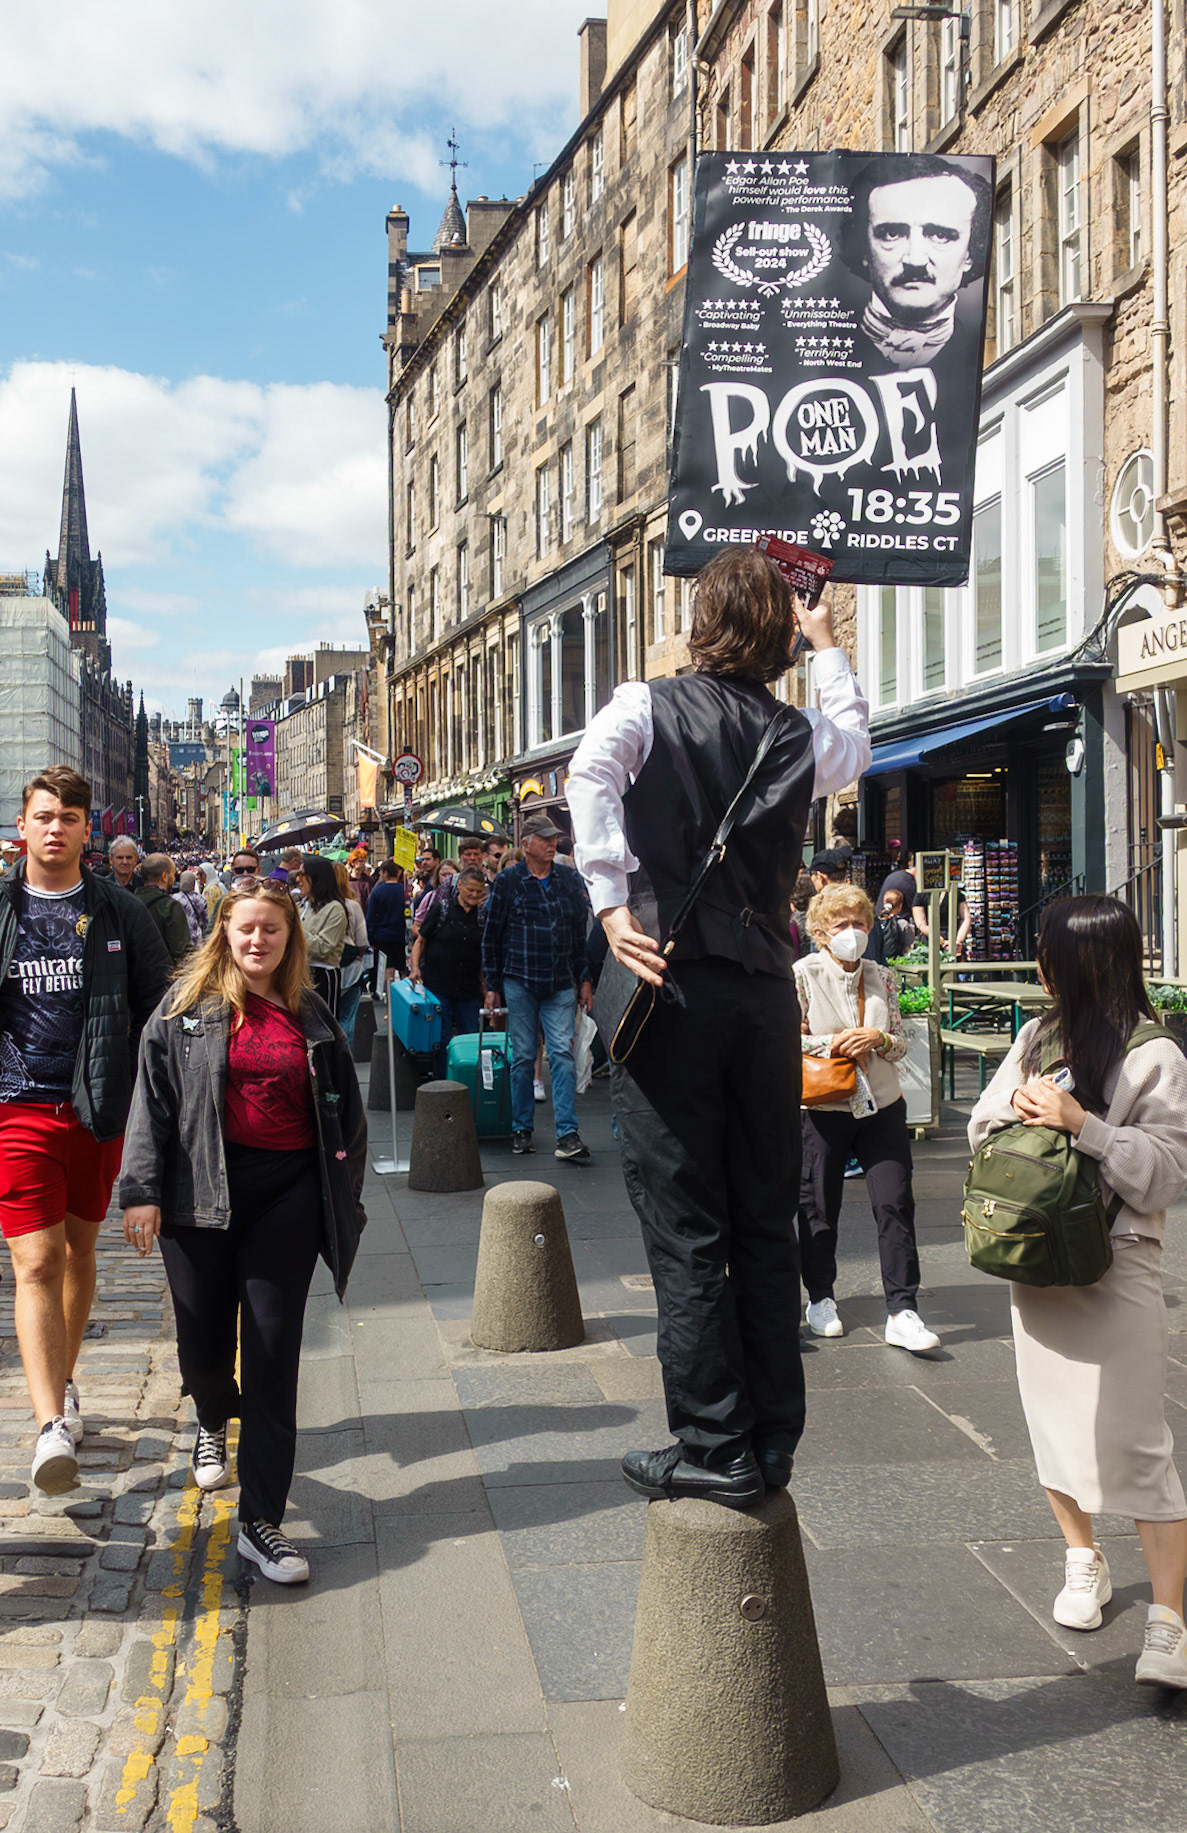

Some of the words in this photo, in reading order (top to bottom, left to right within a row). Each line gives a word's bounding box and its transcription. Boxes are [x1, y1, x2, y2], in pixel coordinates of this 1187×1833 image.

[759, 176, 786, 185] Allan
[788, 176, 809, 185] Poe
[729, 185, 767, 195] himself
[769, 186, 802, 195] would
[803, 186, 827, 195] love
[828, 185, 848, 195] this
[732, 196, 780, 205] powerful
[748, 220, 801, 243] fringe
[735, 246, 778, 257] Sell-out
[779, 246, 809, 257] show
[754, 257, 787, 269] 2024
[703, 321, 740, 331] Broadway
[740, 322, 760, 331] Baby
[787, 320, 828, 329] Everything
[828, 320, 858, 329] Theatre
[712, 364, 773, 373] MyTheatreMates
[847, 360, 863, 368] End
[797, 397, 850, 429] ONE
[699, 367, 942, 508] POE
[800, 426, 856, 456] MAN
[847, 487, 961, 526] 18:35
[847, 533, 929, 550] RIDDLES
[932, 536, 958, 551] CT
[22, 977, 42, 995] FLY
